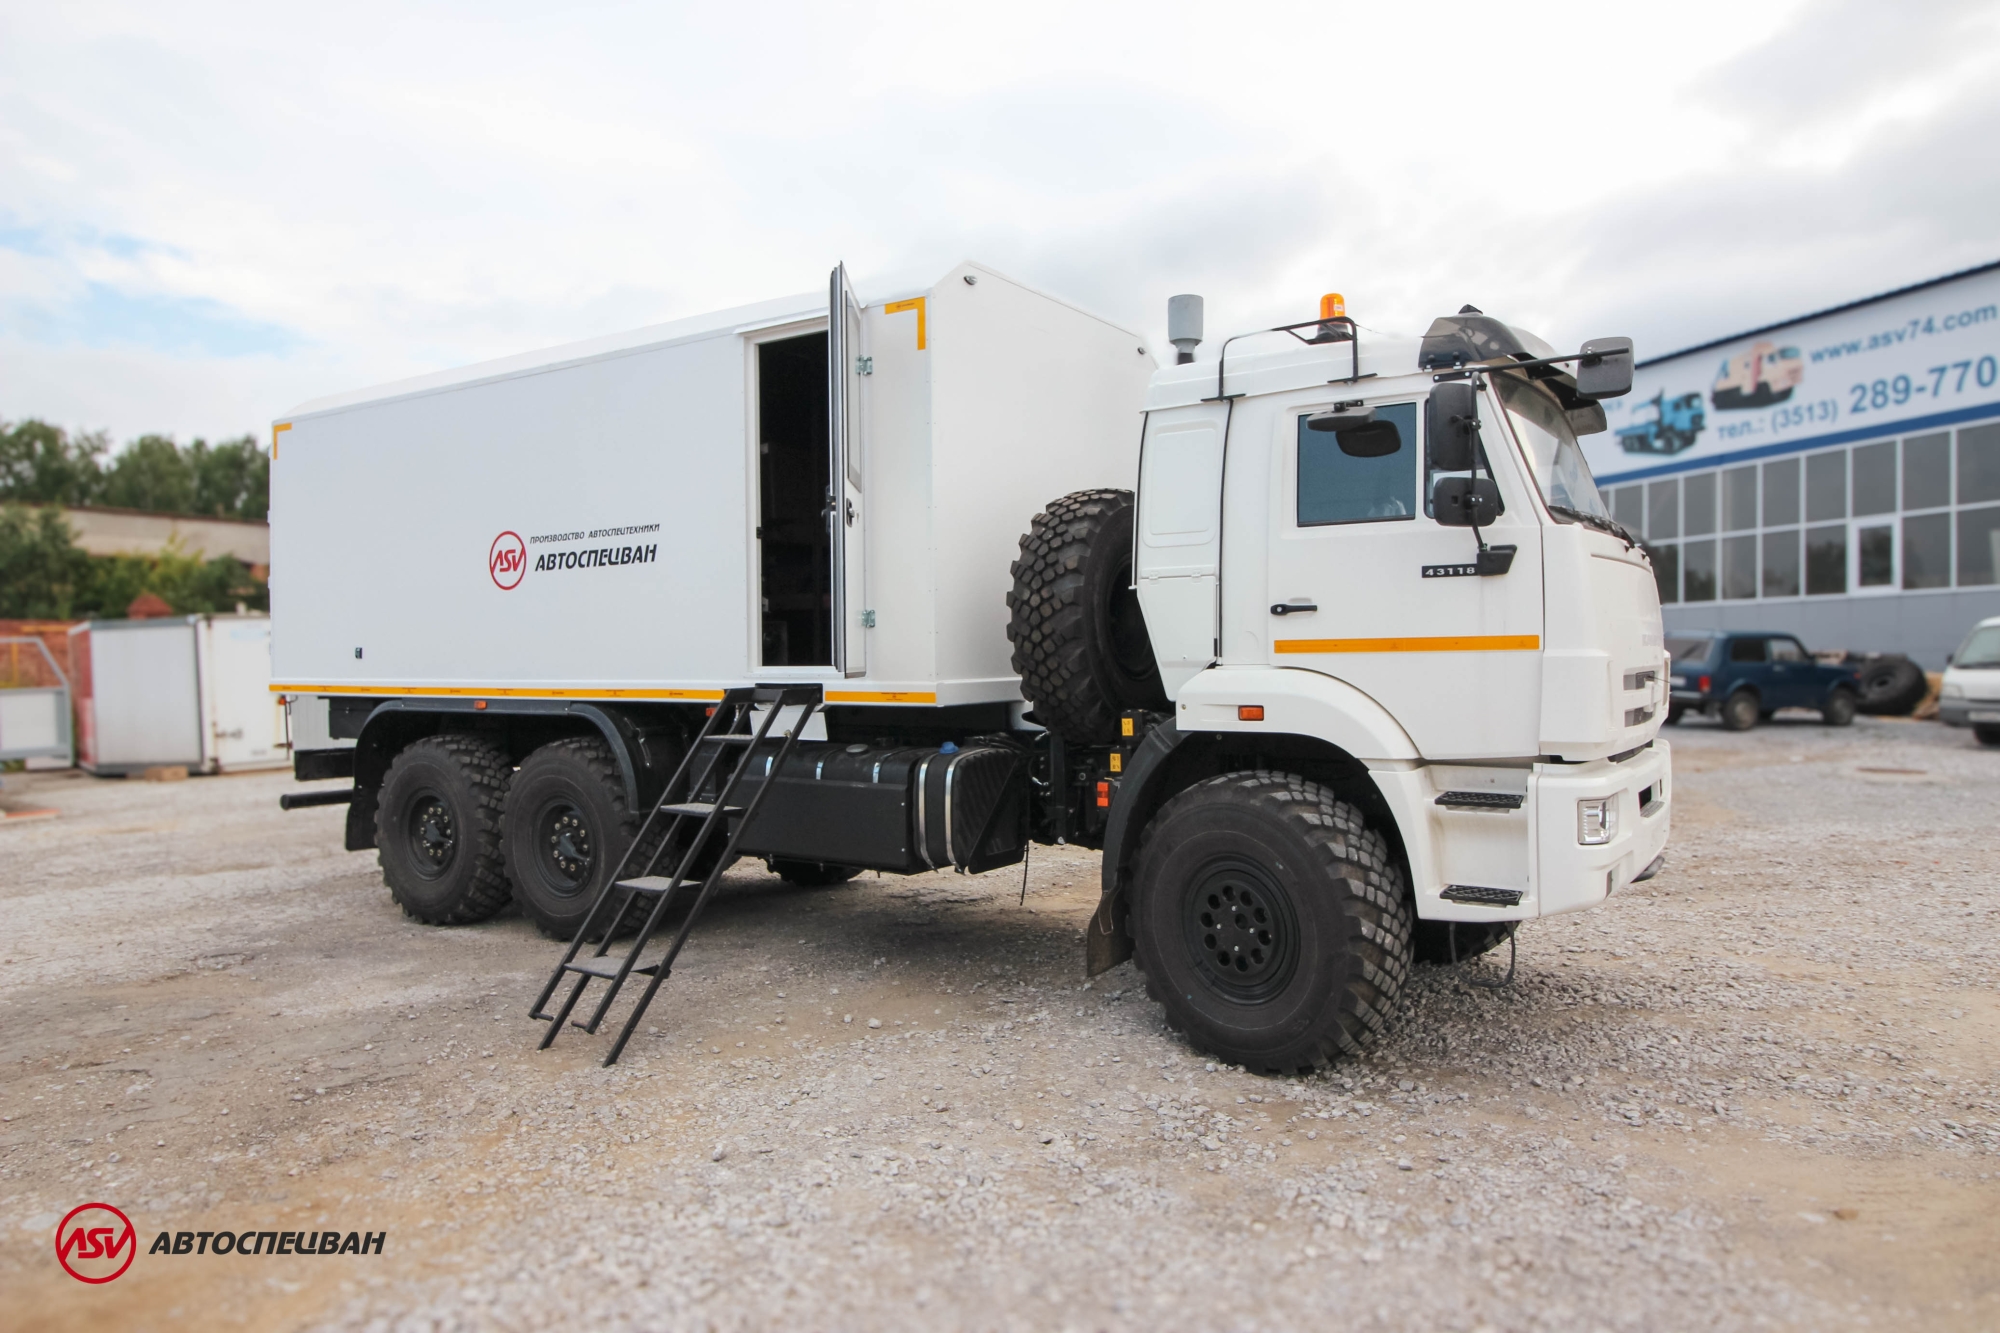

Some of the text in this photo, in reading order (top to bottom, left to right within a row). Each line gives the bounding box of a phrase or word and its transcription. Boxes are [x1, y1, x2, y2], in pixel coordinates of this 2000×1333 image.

[1809, 304, 1998, 364] www.asv74.com
[1771, 399, 1838, 433] (3513)
[1850, 355, 1998, 414] 289-770
[530, 523, 660, 544] ПРОИЗВОДСТВО АВТОСПЕЦТЕХНИКИ
[535, 544, 657, 571] АВТОСПЕЦВАН
[1425, 566, 1475, 576] 43118
